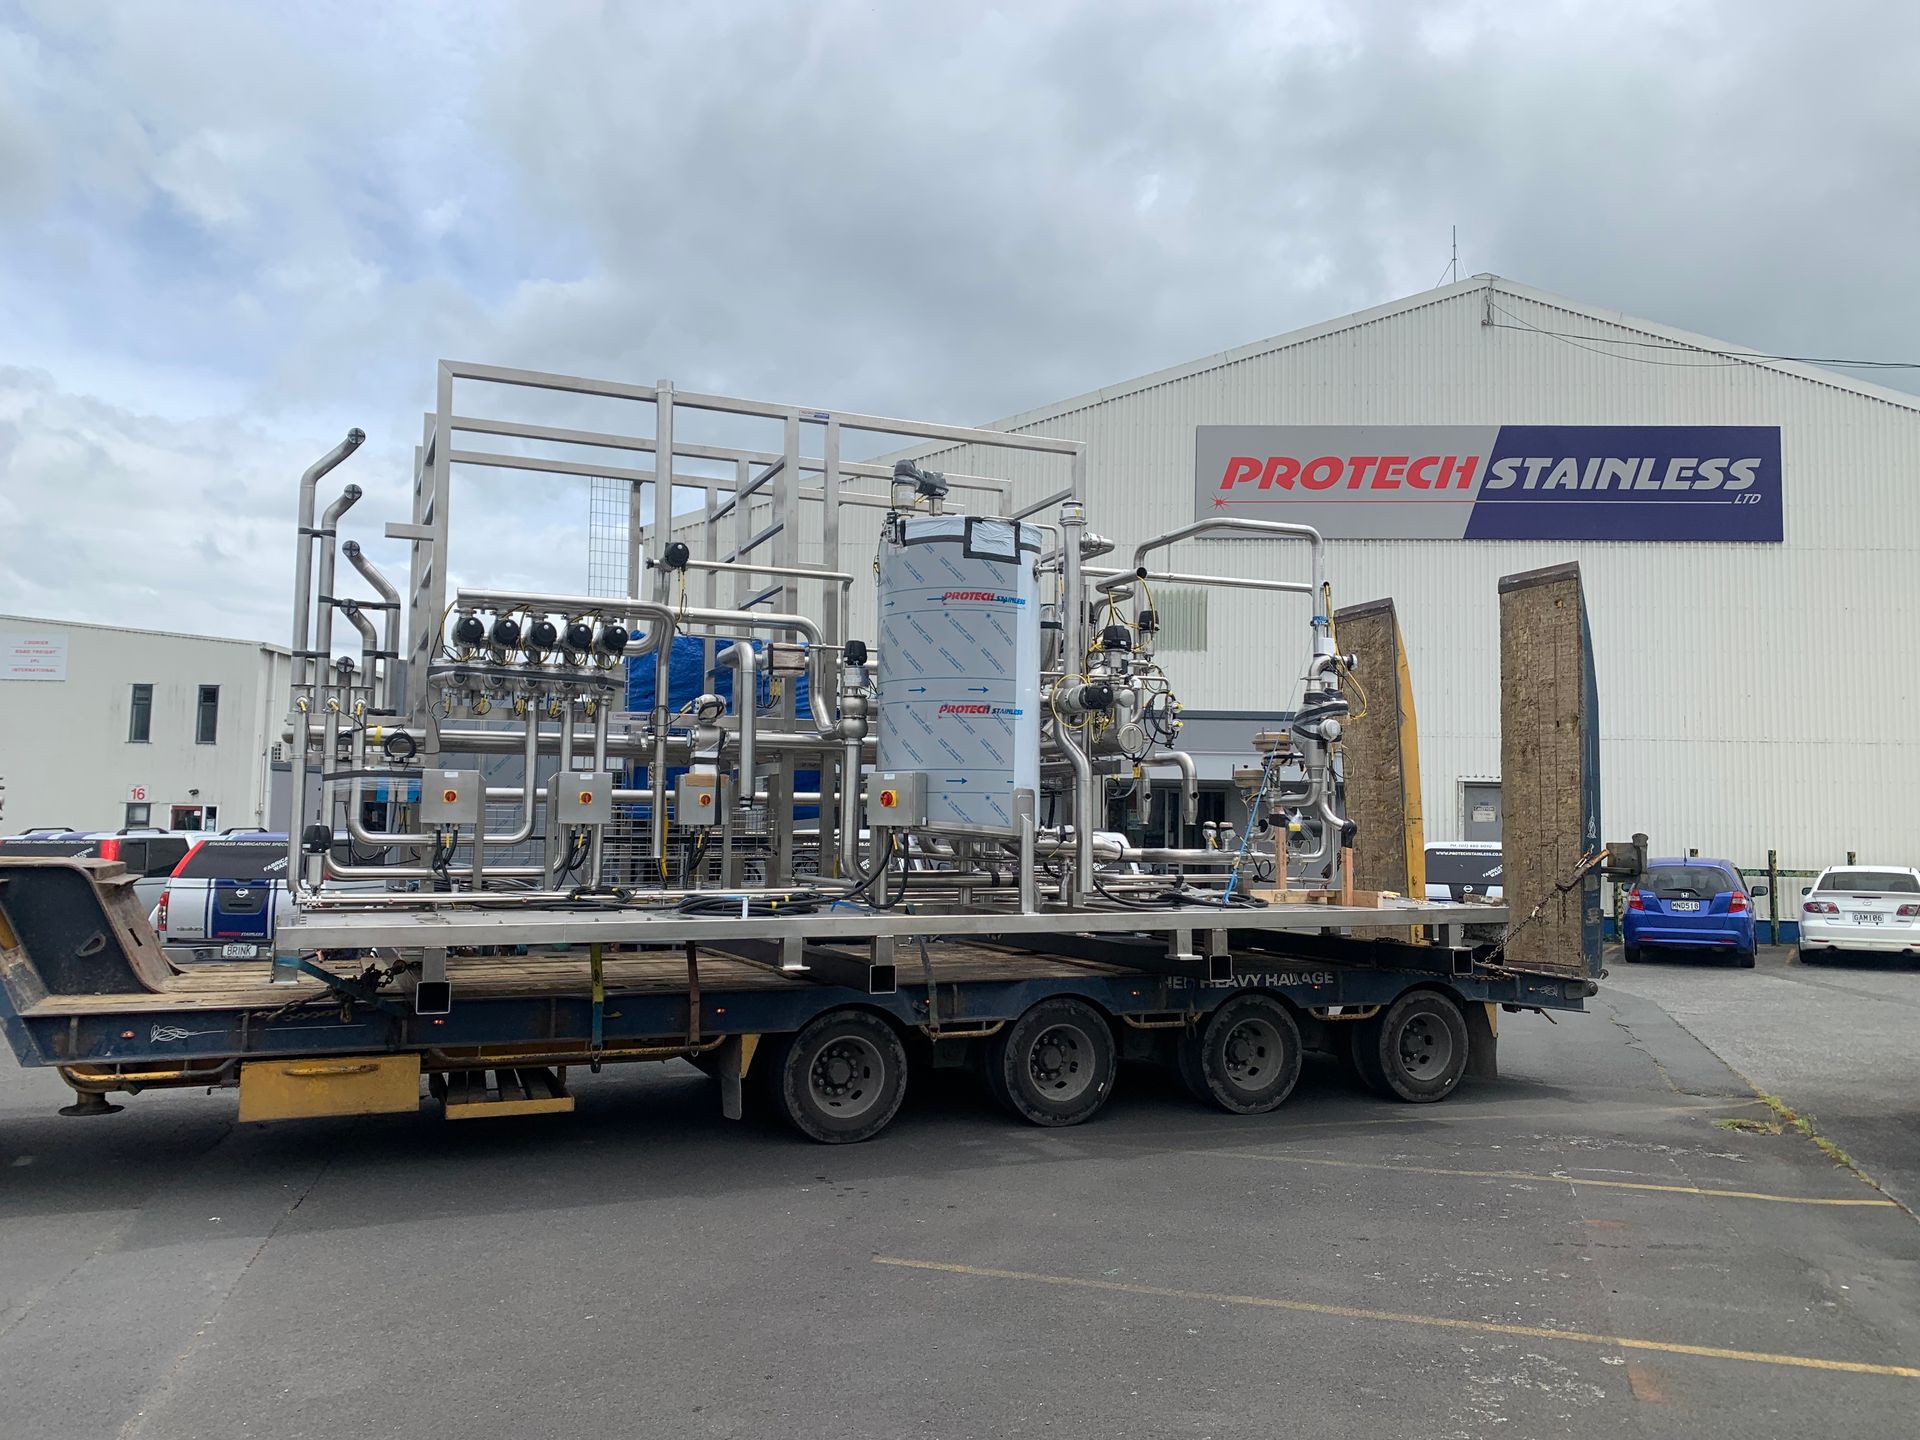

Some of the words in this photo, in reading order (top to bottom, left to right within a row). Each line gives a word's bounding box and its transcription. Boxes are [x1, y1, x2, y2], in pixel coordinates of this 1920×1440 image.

[1219, 455, 1480, 490] PROTECH
[1485, 457, 1762, 490] STAINLESS
[1734, 493, 1762, 505] LTD
[943, 591, 995, 601] PROTECH
[995, 595, 1026, 605] STAINLESS
[938, 704, 991, 715] PROTECH
[991, 707, 1024, 716] STAINLESS
[131, 788, 145, 800] 16
[263, 856, 289, 872] FABRICA
[1671, 902, 1700, 910] MND518
[1853, 914, 1883, 922] GAM106
[226, 946, 252, 956] BRINK
[1265, 971, 1335, 986] HAULAGE
